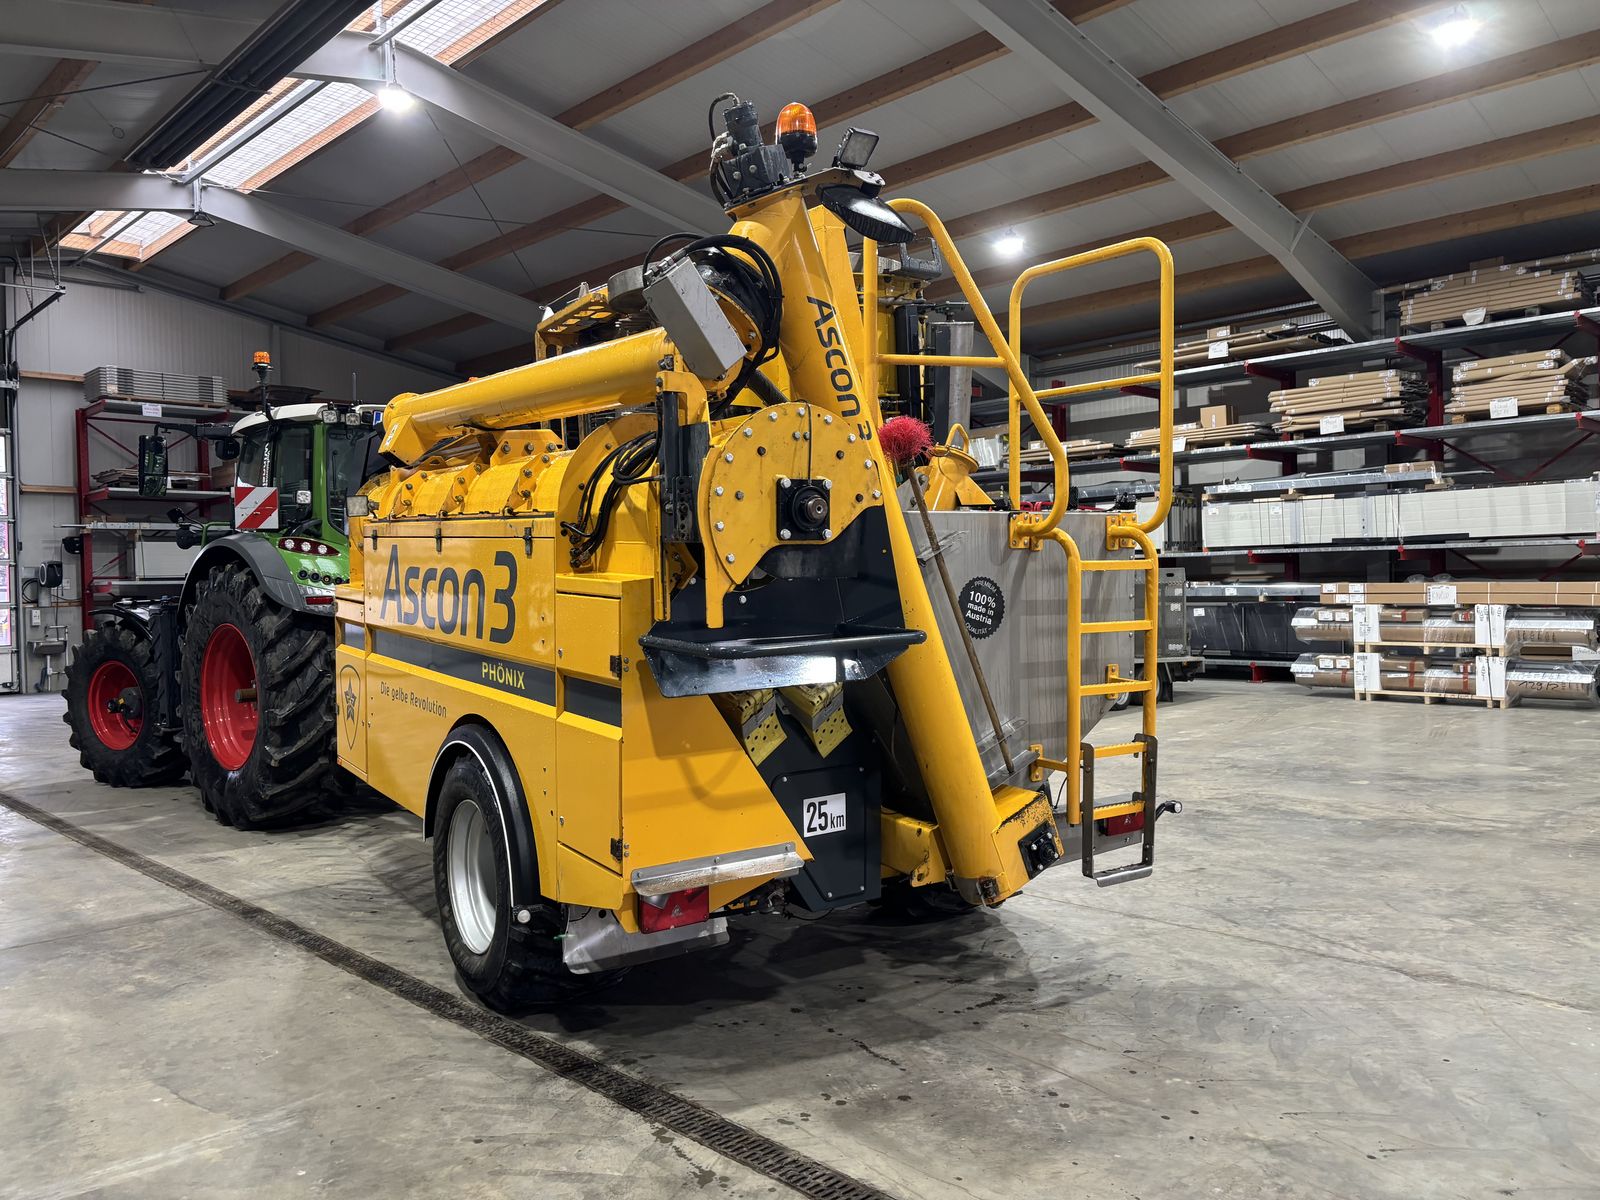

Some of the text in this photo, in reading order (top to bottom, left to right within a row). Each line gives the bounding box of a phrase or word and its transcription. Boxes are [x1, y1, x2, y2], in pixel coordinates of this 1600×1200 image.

[974, 580, 997, 593] PREMIUM
[970, 591, 996, 608] 100%
[966, 610, 992, 625] Austria
[967, 603, 994, 616] made in
[481, 661, 526, 690] PHÖNIX
[380, 681, 447, 718] Die gelbe Revolution
